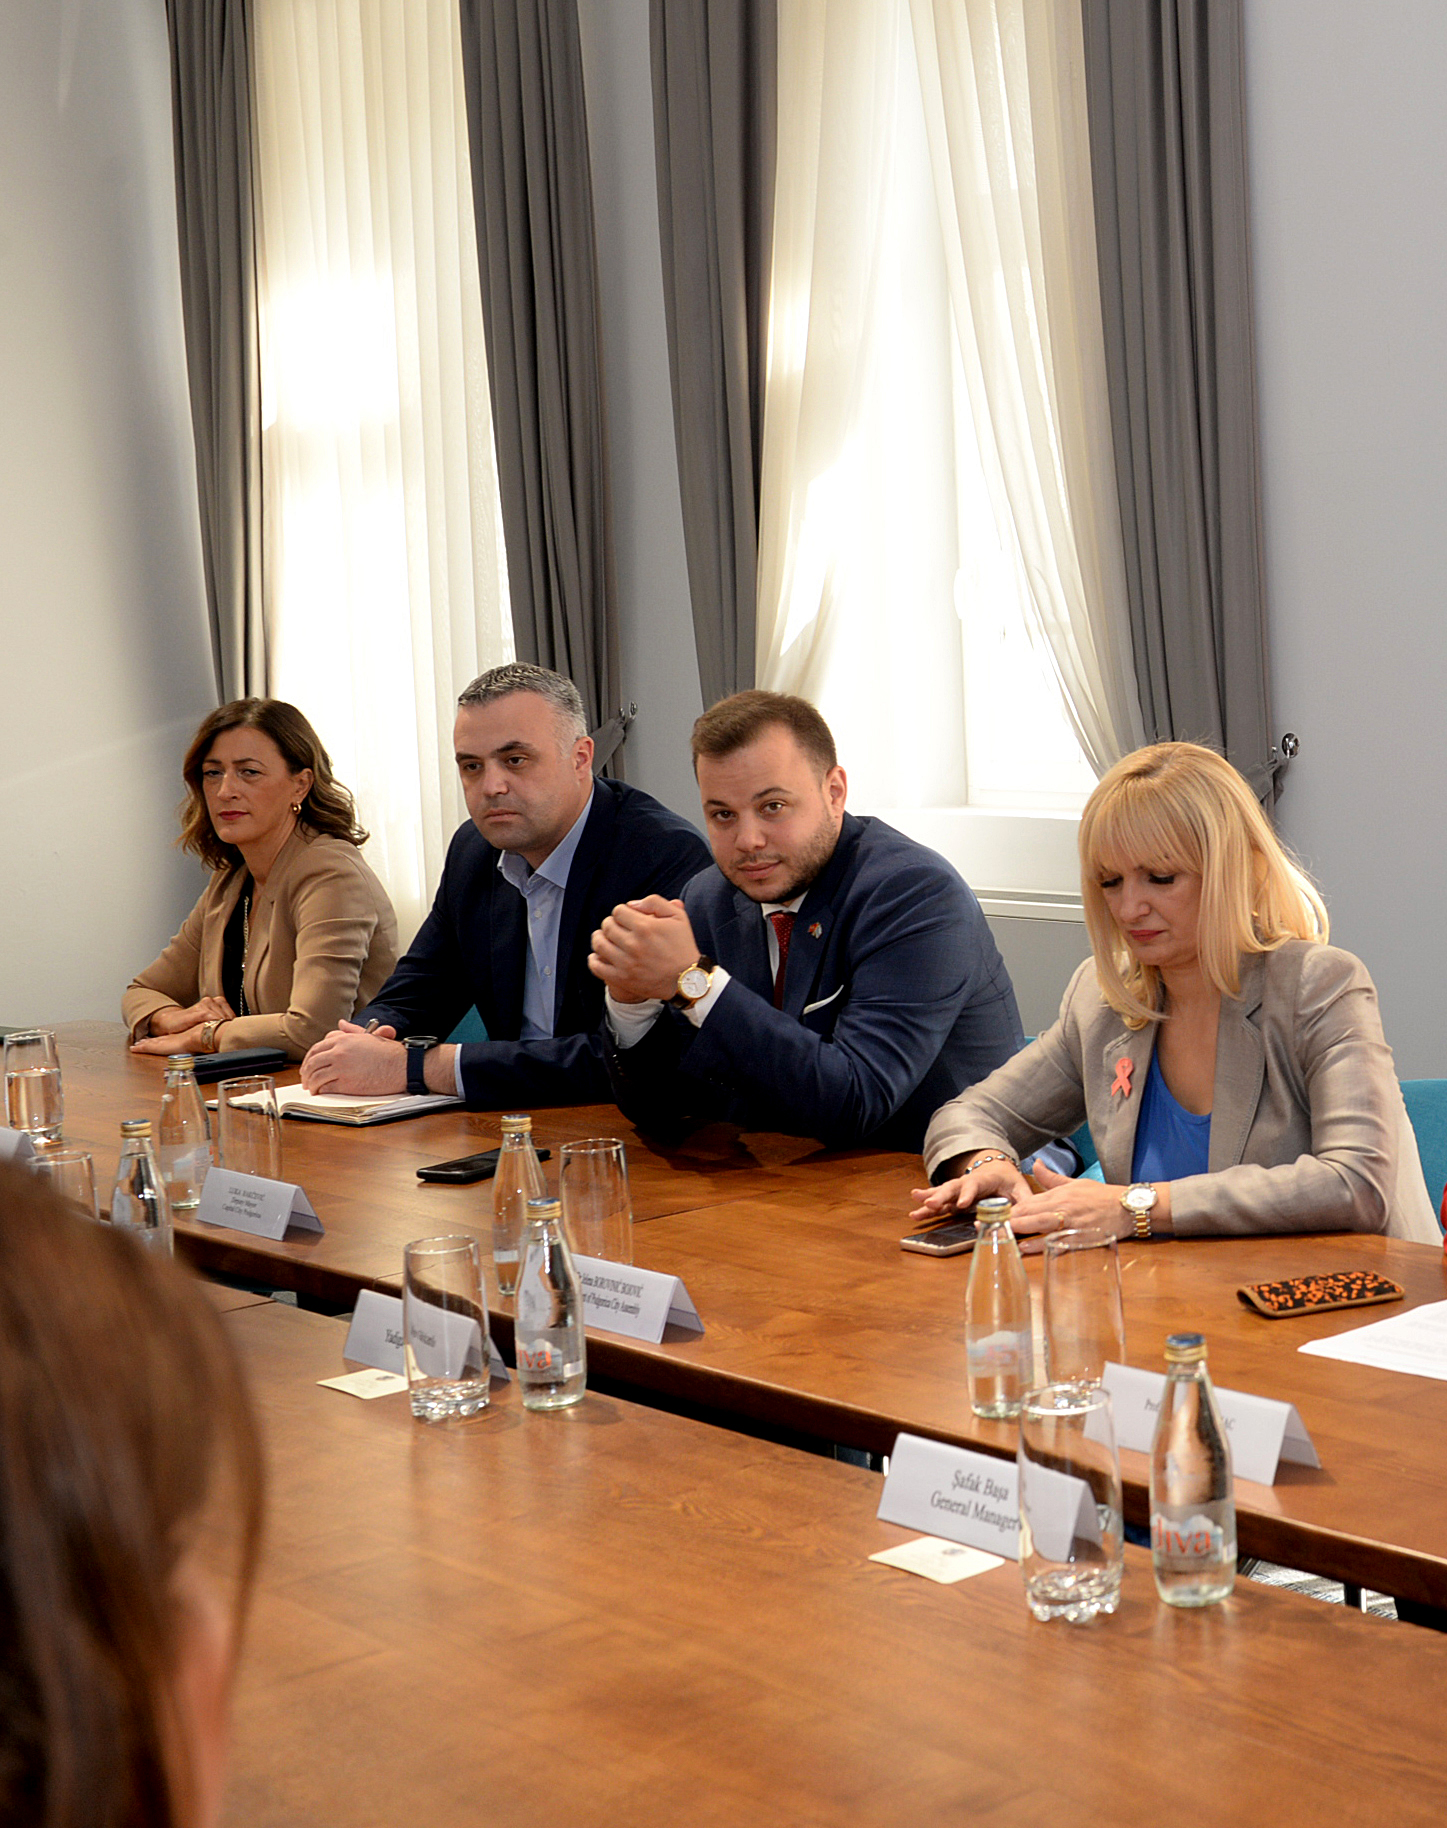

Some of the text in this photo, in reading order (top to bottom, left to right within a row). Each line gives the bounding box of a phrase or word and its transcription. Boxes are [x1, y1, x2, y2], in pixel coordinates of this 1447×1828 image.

[951, 1469, 983, 1493] Şafak
[983, 1478, 1010, 1503] Başa
[930, 1490, 1023, 1533] General Manager
